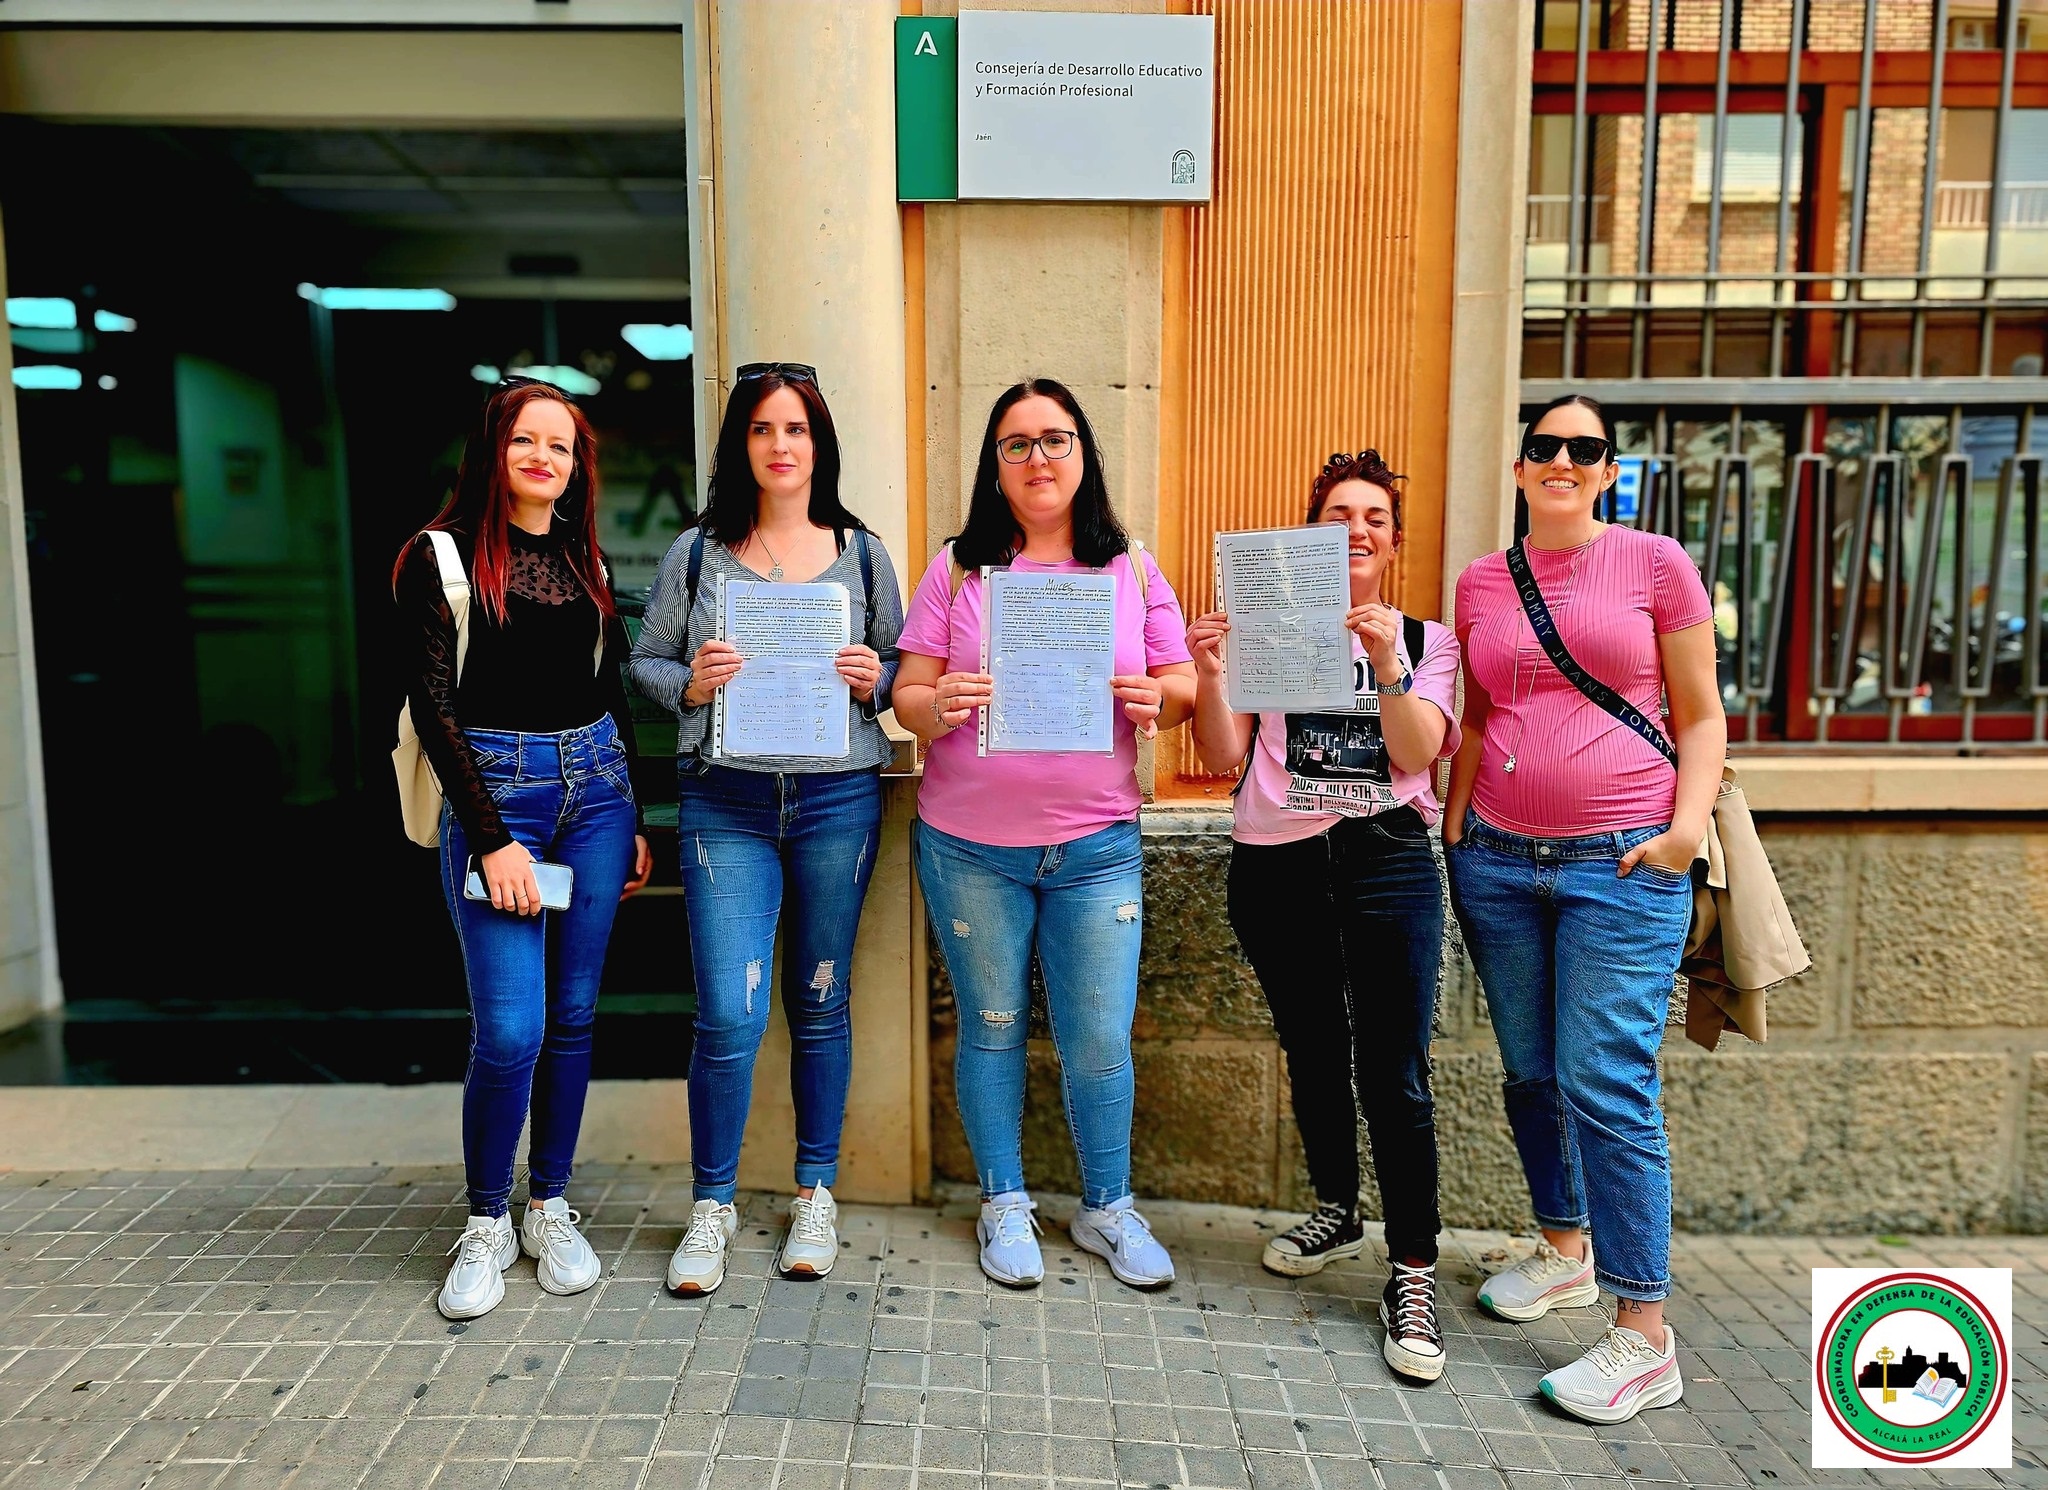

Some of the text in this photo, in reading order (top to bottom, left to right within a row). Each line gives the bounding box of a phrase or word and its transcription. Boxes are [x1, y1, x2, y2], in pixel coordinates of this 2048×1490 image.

[975, 61, 1203, 78] Consejería de Desarrollo Educativo
[975, 82, 1134, 97] y Formación Profesional
[975, 133, 992, 141] Jaén
[1509, 546, 1672, 756] ANS TOMMY JEANS TOMMY
[1326, 783, 1349, 796] JULY
[1352, 784, 1371, 799] 5TH
